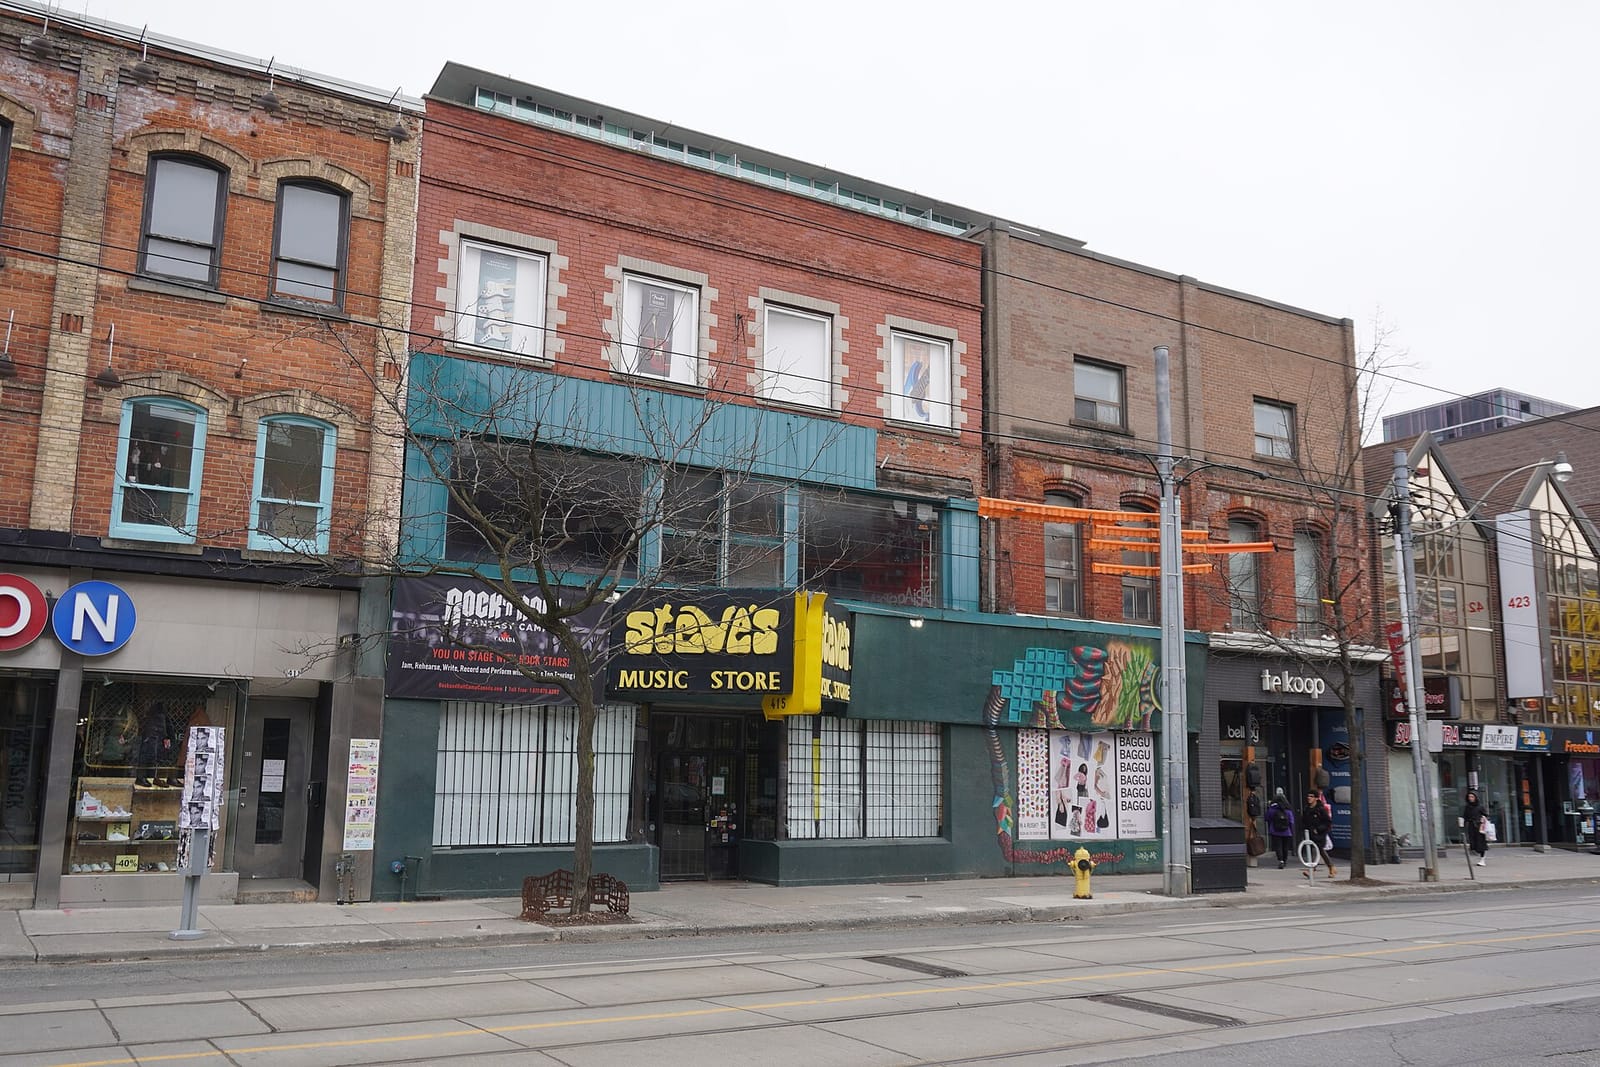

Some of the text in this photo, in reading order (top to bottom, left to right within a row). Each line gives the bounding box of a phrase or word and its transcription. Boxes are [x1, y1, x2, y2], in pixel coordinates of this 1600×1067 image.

[1508, 595, 1531, 609] 423
[465, 618, 516, 631] FANTASY
[432, 648, 451, 660] YOU
[453, 650, 466, 661] ON
[467, 651, 495, 663] STAGE
[618, 670, 782, 691] MUSIC STORE
[1260, 668, 1326, 699] te koop
[770, 697, 786, 711] 415
[1119, 736, 1151, 748] BAGGU
[1483, 733, 1515, 745] EMPIRE
[1564, 739, 1600, 753] Freedom
[1119, 749, 1151, 760] BAGGU
[1119, 762, 1152, 773] BAGGU
[1120, 775, 1152, 786] BAGGU
[1120, 787, 1152, 799] BAGGU
[1121, 800, 1153, 811] BAGGU
[115, 858, 138, 868] -40%
